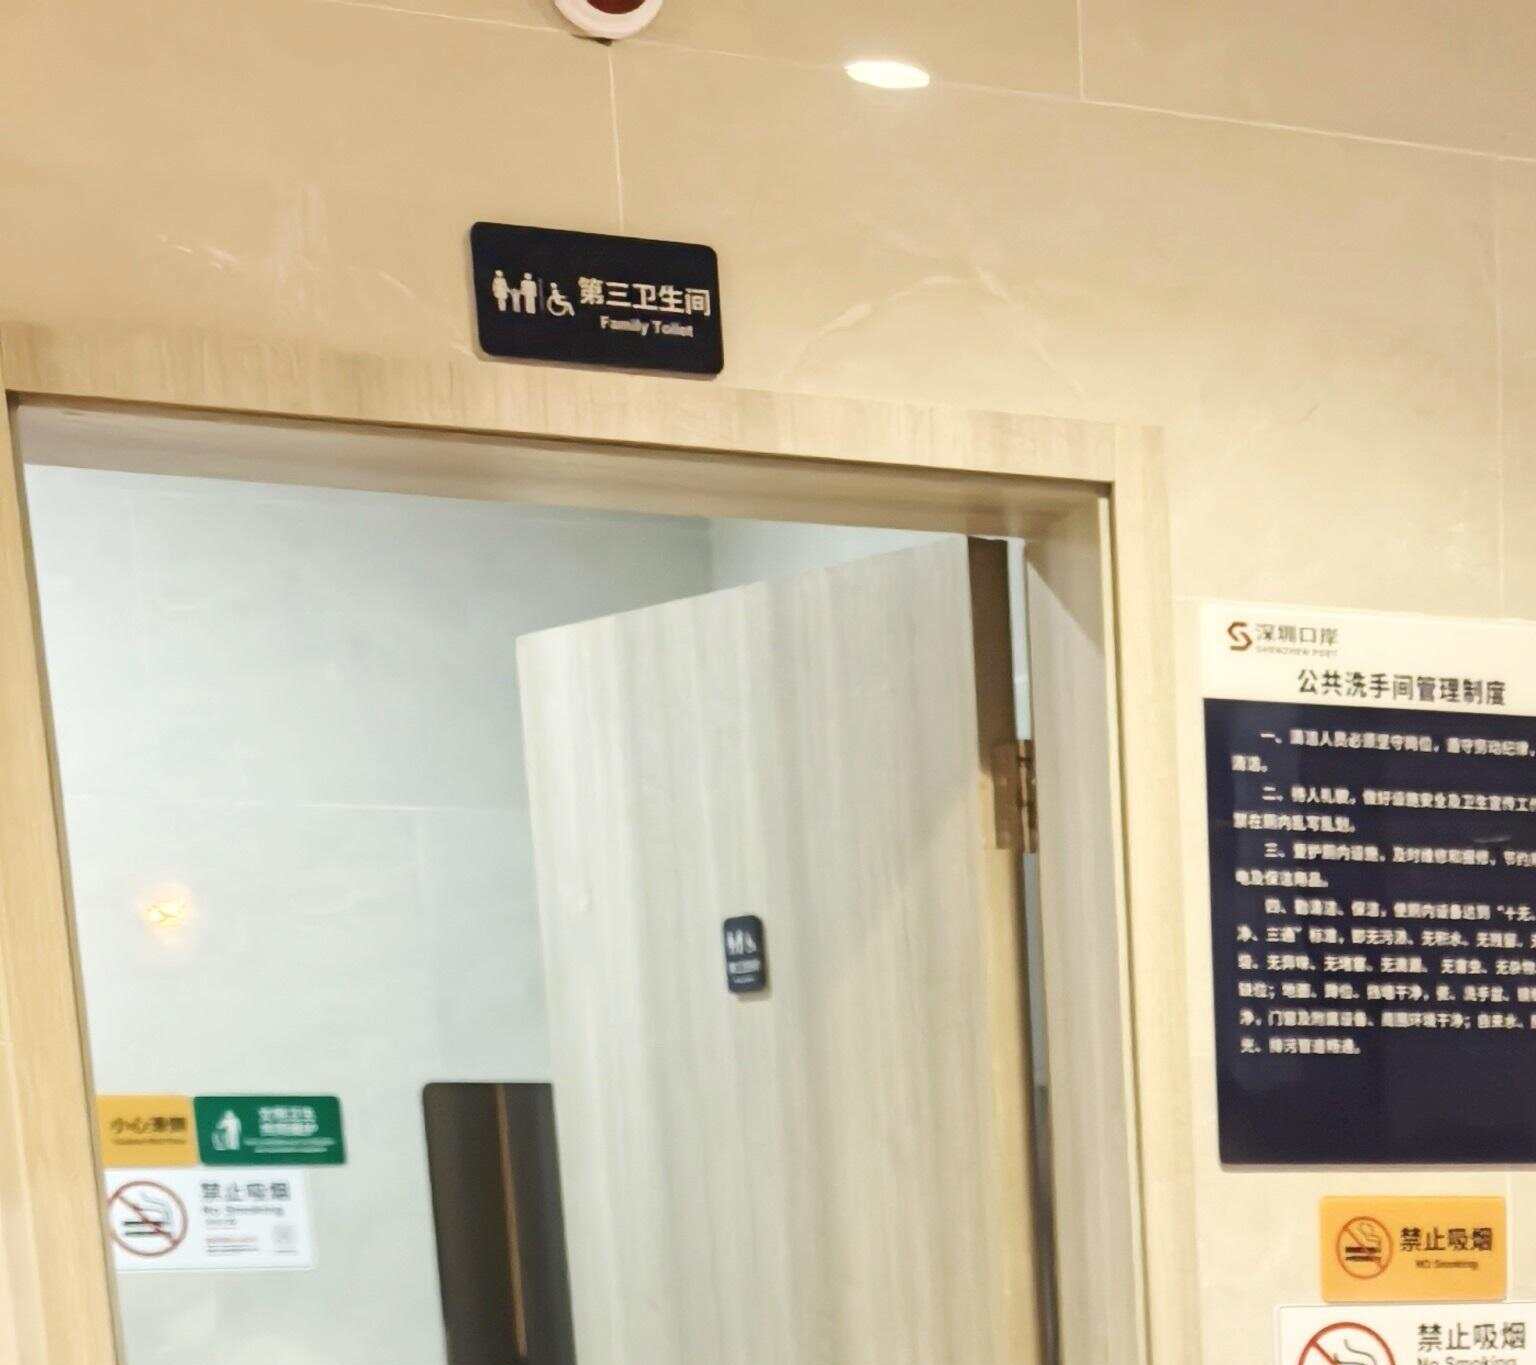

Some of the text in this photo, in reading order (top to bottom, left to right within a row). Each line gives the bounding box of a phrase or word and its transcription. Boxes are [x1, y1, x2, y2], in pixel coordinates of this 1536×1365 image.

[578, 276, 711, 317] 第三卫生间
[1255, 623, 1339, 647] 深圳口岸
[1298, 669, 1505, 706] 公共洗手间管理制度
[1400, 1227, 1493, 1252] 禁止吸烟
[1417, 1321, 1526, 1352] 禁止吸烟
